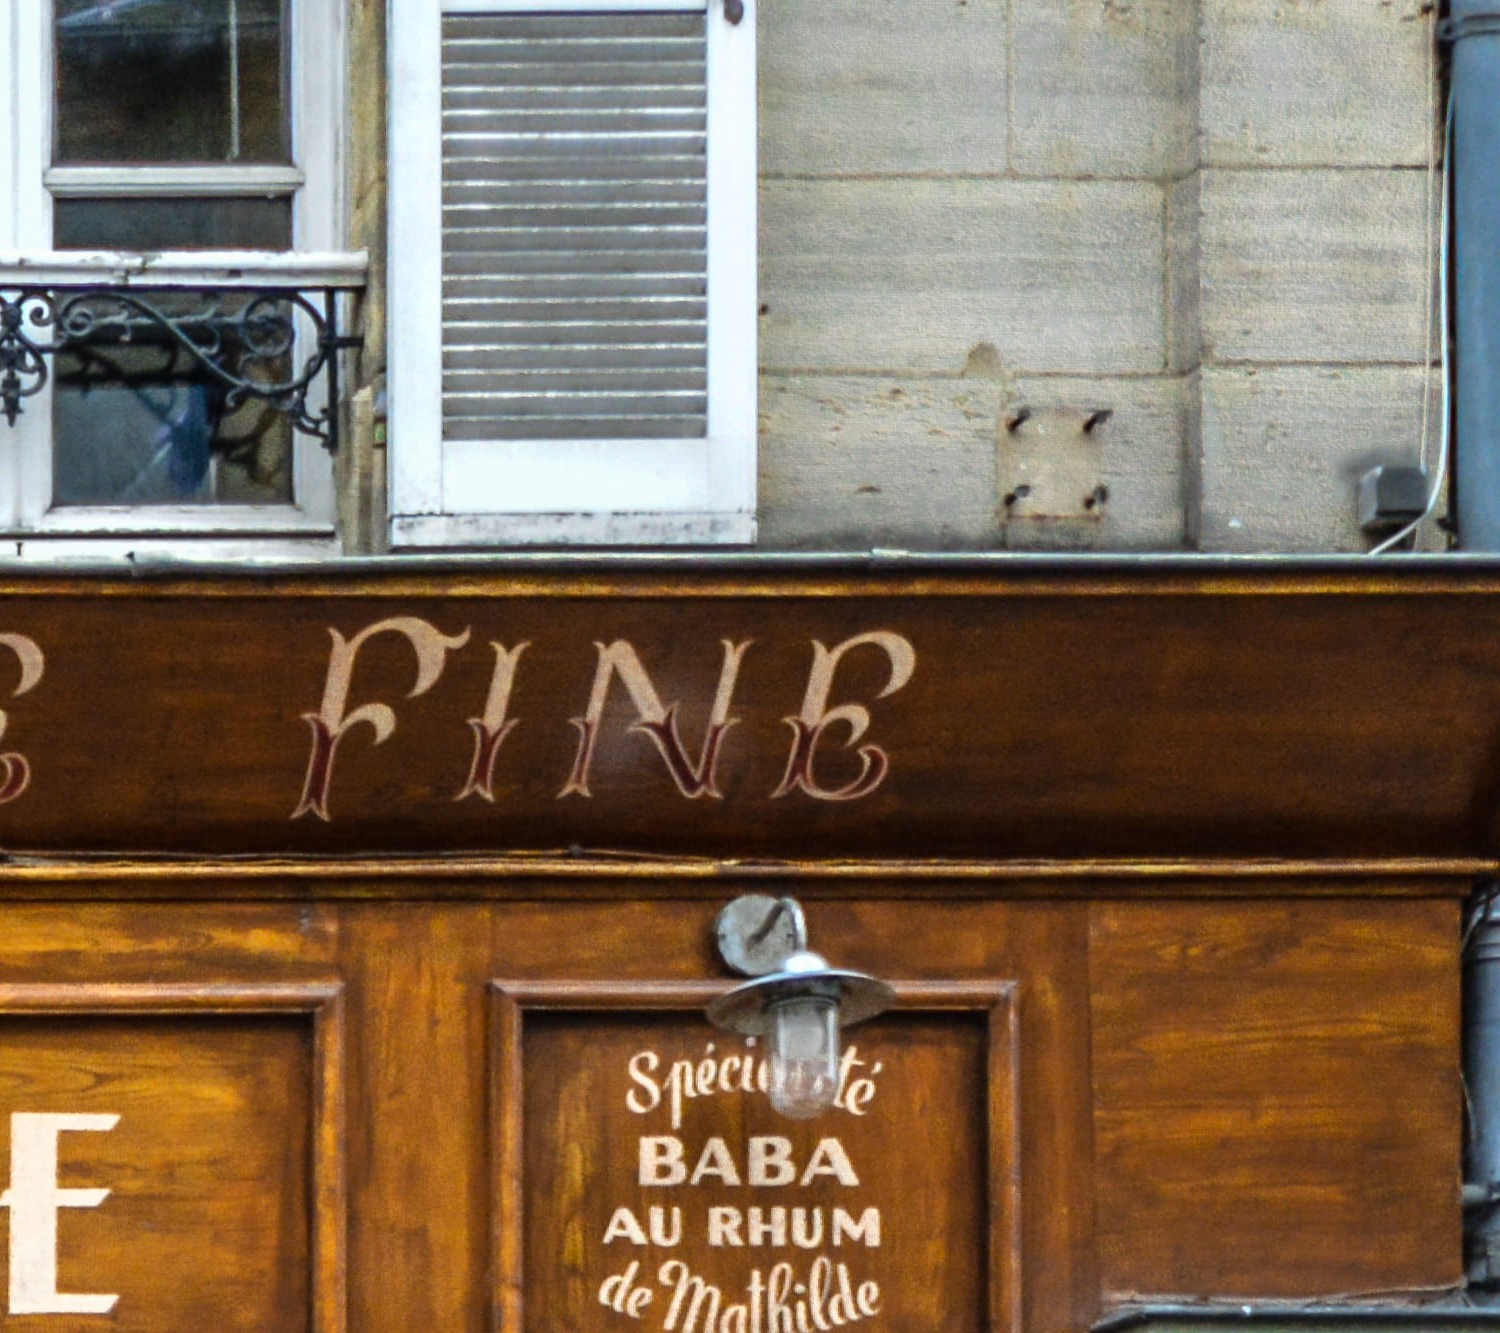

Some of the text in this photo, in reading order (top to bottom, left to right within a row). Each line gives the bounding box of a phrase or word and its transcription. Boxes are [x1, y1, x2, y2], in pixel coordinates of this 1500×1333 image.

[292, 612, 920, 824] FINE
[638, 1136, 861, 1187] BABA
[603, 1206, 882, 1249] AU RHUM
[599, 1260, 654, 1320] de
